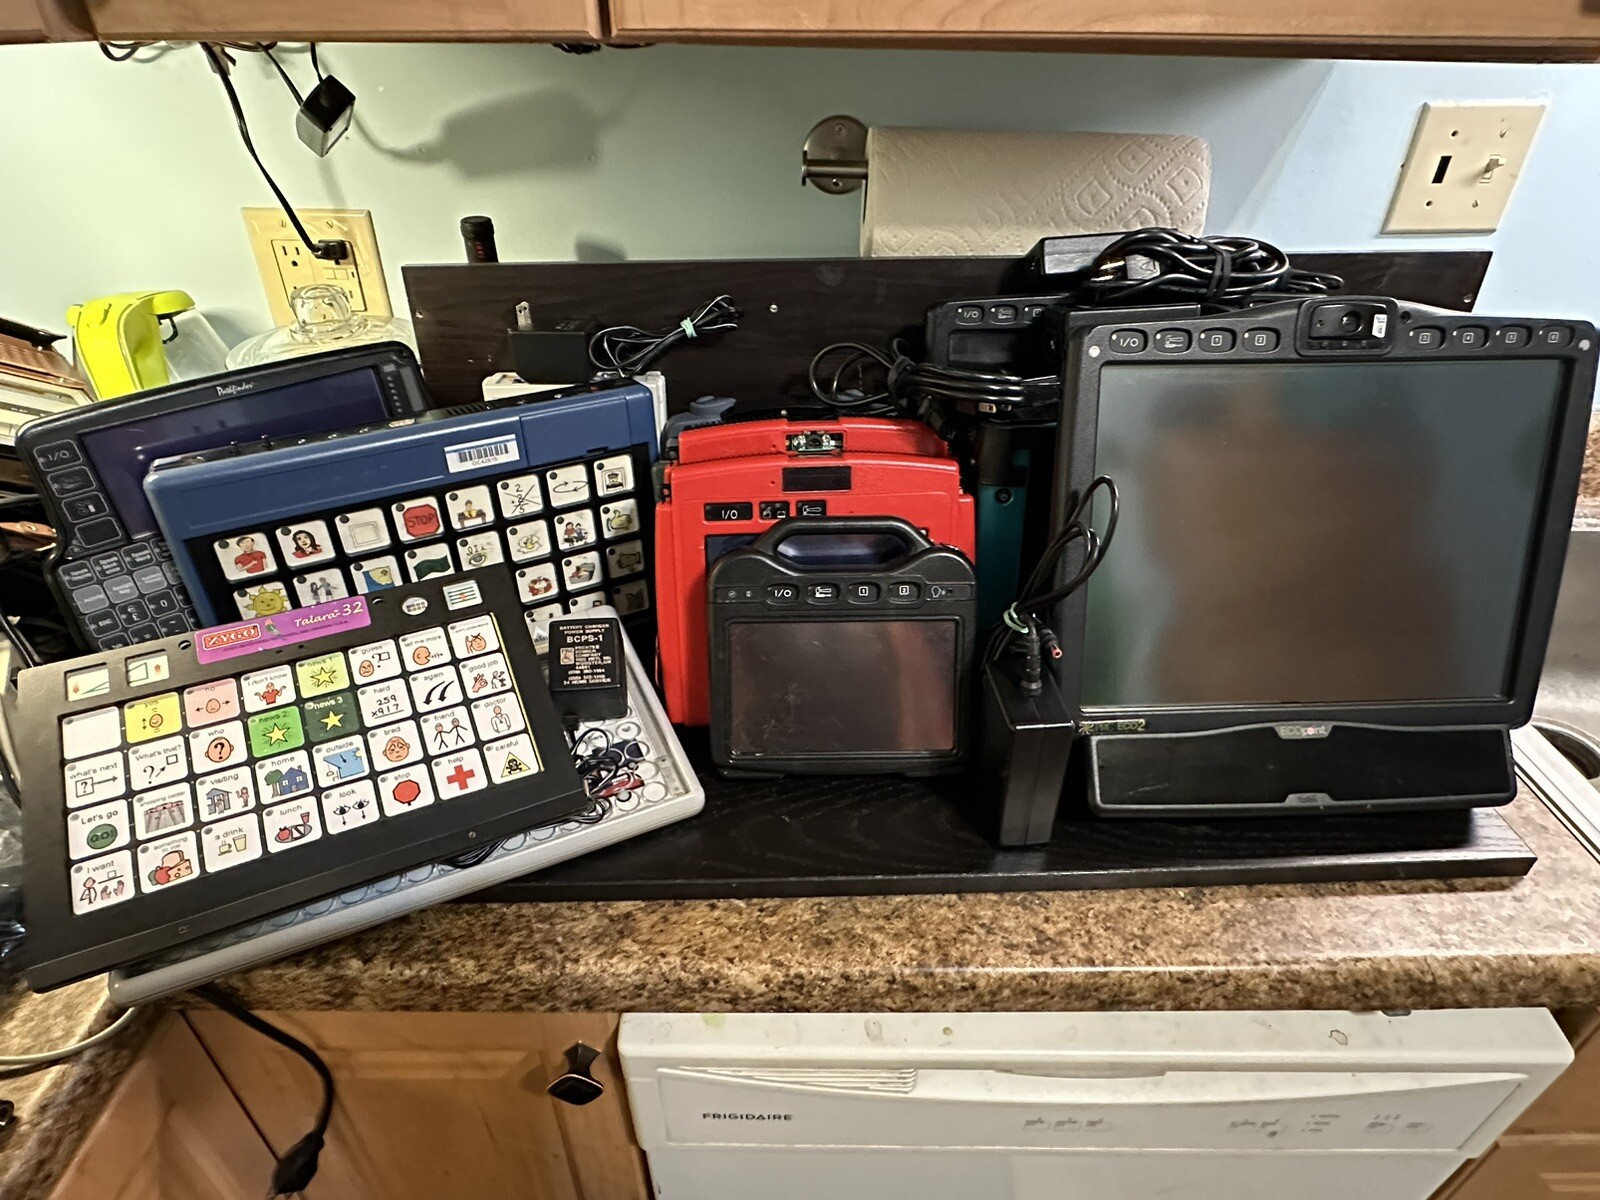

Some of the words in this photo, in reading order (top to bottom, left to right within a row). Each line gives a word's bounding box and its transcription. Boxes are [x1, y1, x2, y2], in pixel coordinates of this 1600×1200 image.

[963, 310, 979, 319] I/O
[1119, 337, 1138, 347] I/O
[721, 509, 738, 520] I/O
[406, 512, 435, 529] STOP
[774, 588, 792, 598] I/O
[208, 626, 258, 646] ZYGO
[566, 635, 603, 643] BCPS-1
[468, 662, 486, 673] good
[486, 660, 499, 669] job
[269, 672, 288, 681] know
[423, 671, 445, 682] again
[373, 685, 391, 694] hard
[314, 700, 337, 710] news
[336, 696, 344, 704] 3
[376, 694, 398, 706] 259
[484, 697, 507, 708] doctor
[258, 714, 281, 724] news
[282, 710, 289, 718] 2
[433, 711, 455, 721] friend
[207, 728, 225, 737] who
[383, 726, 402, 736] tired
[163, 743, 182, 755] that?
[325, 740, 354, 754] outside
[495, 740, 519, 752] careful
[271, 755, 296, 767] home
[447, 755, 464, 766] help
[99, 761, 118, 772] next
[209, 772, 239, 785] visiting
[393, 772, 411, 782] stop
[339, 788, 357, 799] look
[279, 804, 303, 816] lunch
[80, 813, 104, 825] Let's
[106, 809, 119, 819] go
[222, 827, 244, 839] drink
[91, 860, 115, 873] want
[702, 1112, 793, 1121] FRIGIDAIRE
